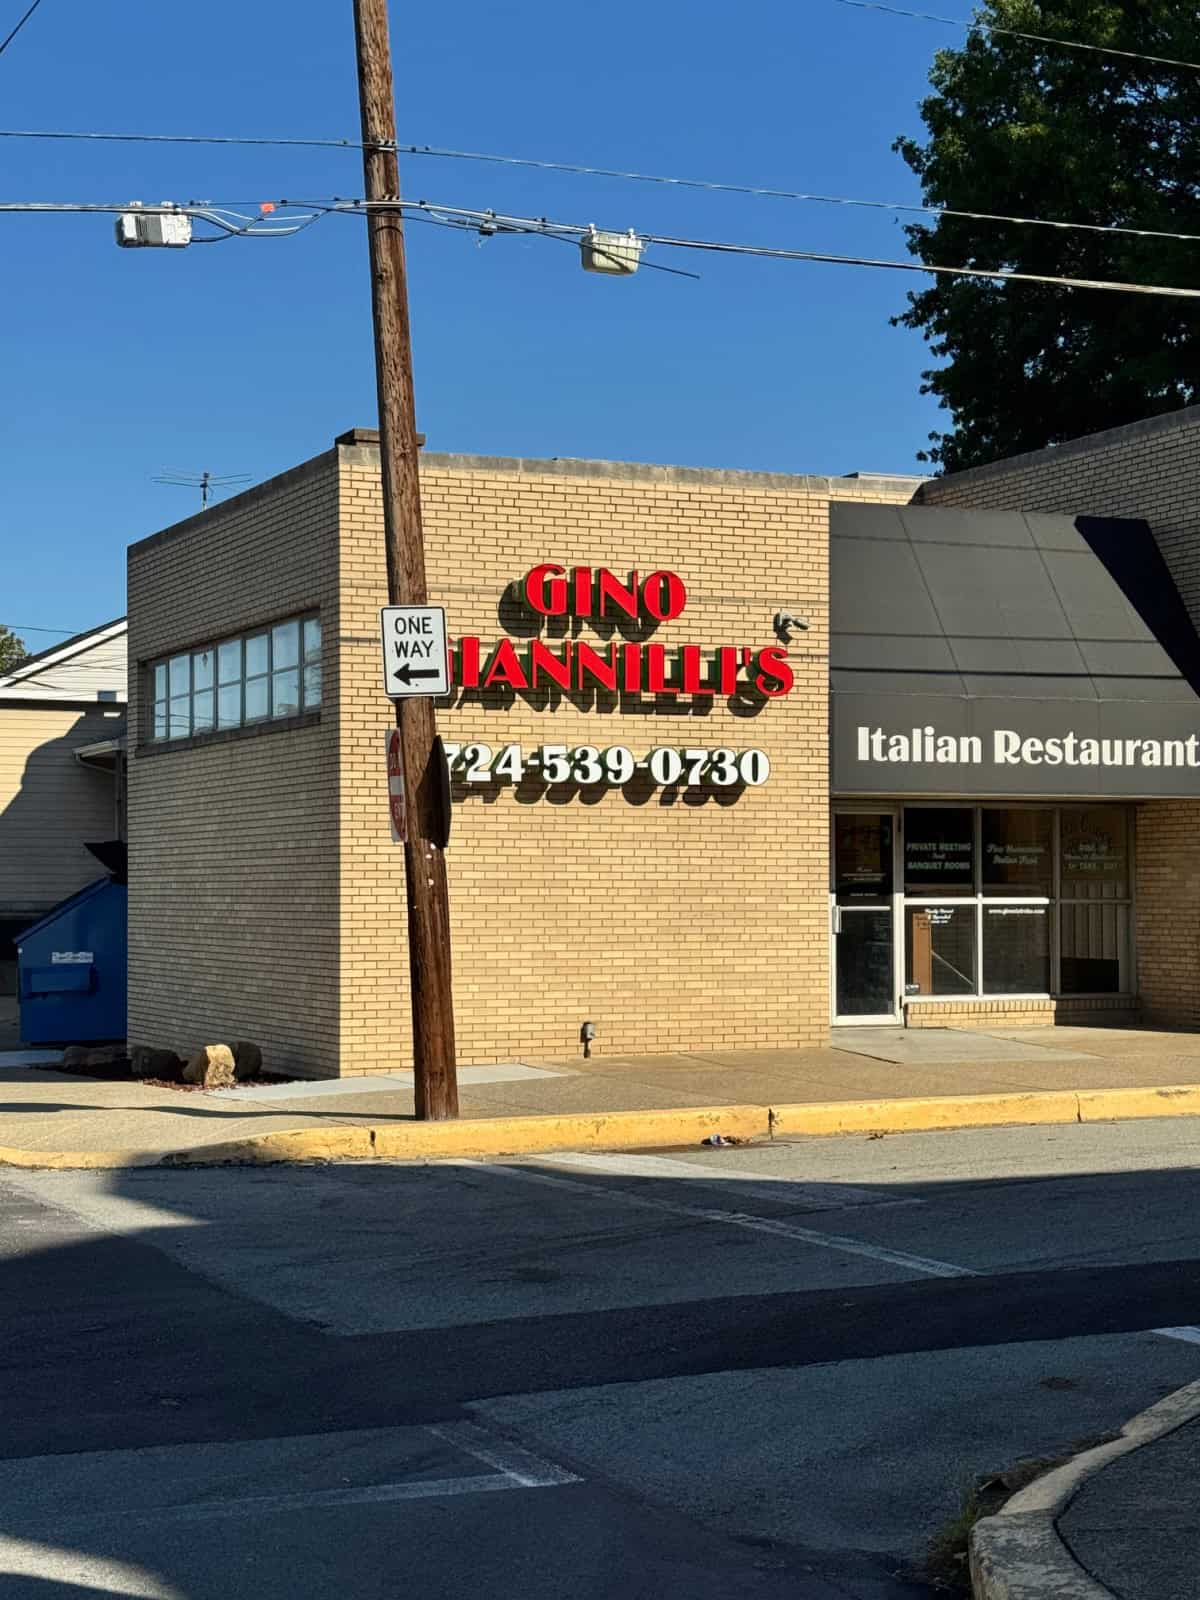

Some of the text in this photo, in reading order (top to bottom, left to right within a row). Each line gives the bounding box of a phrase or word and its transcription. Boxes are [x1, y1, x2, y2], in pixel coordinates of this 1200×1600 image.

[525, 563, 687, 622] GINO
[394, 615, 433, 635] ONE
[394, 639, 434, 658] WAY
[448, 635, 795, 697] IANNILLI'S
[446, 744, 770, 787] 724-539-0730
[857, 726, 1200, 767] Italian Restaurant
